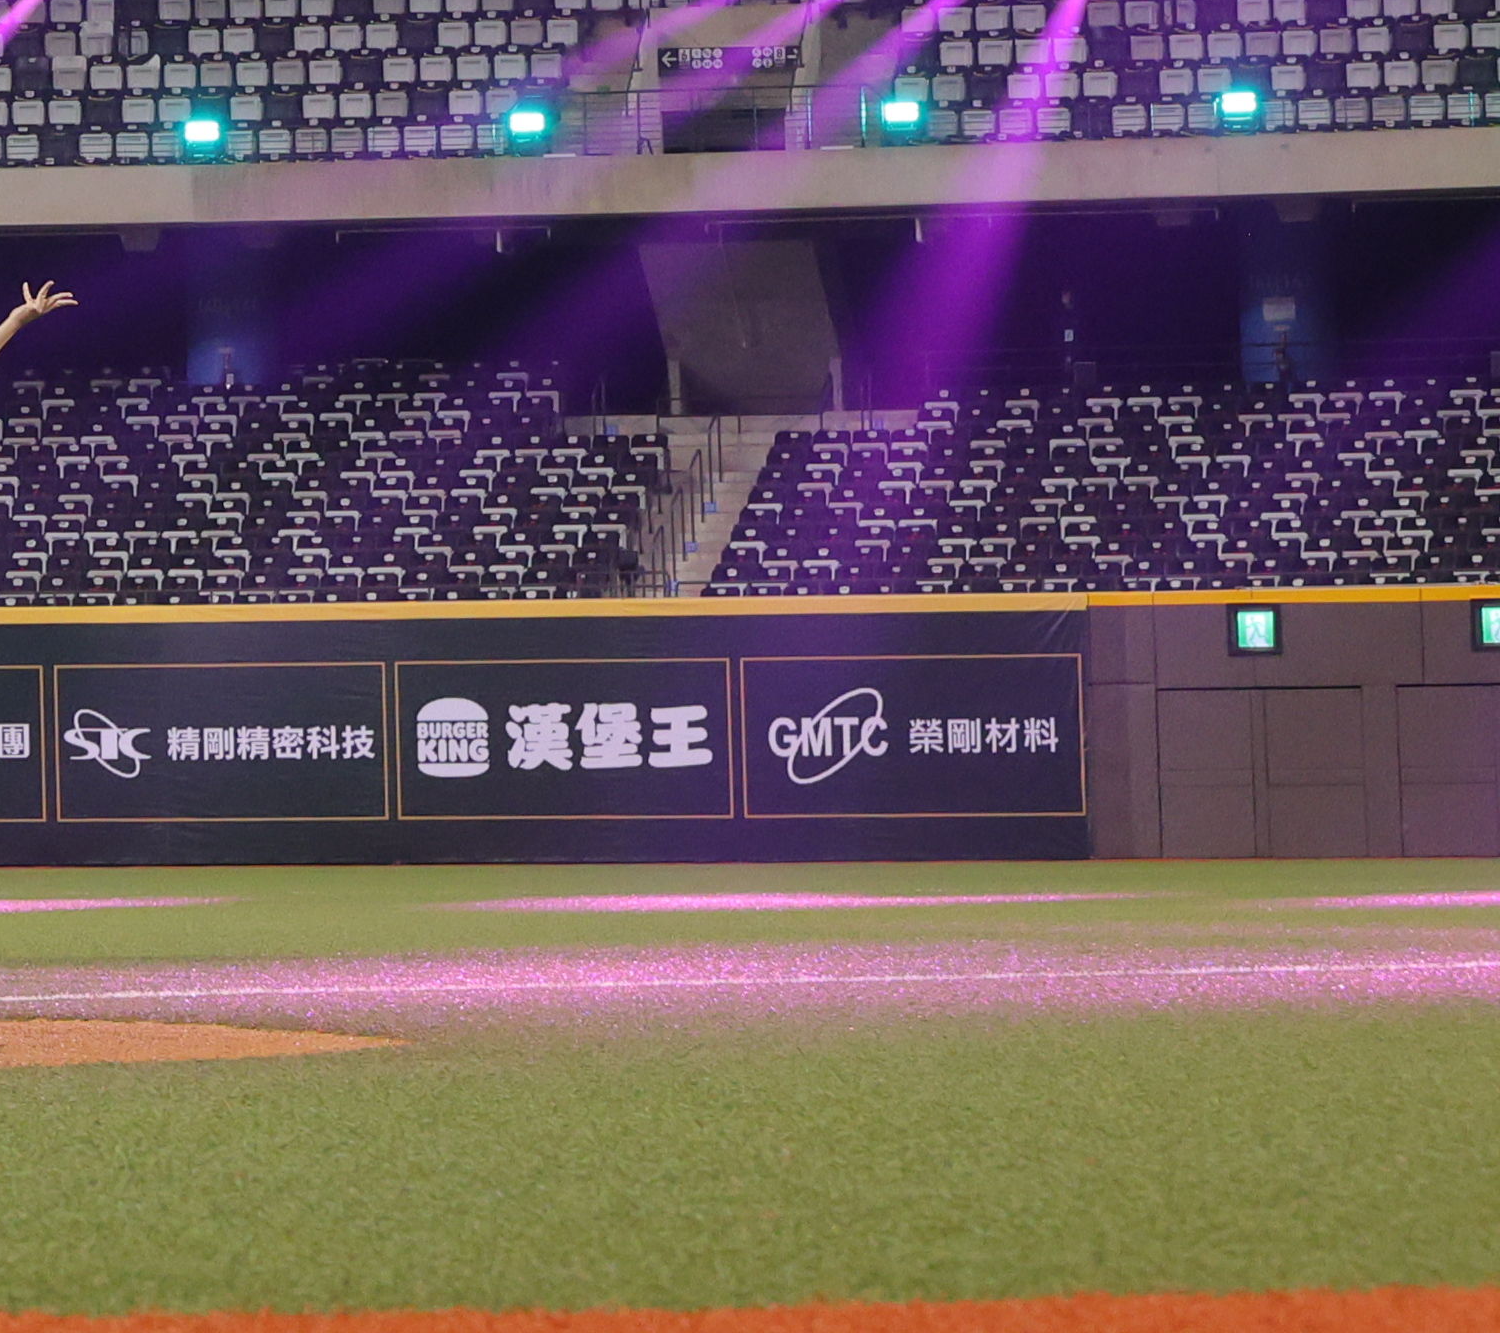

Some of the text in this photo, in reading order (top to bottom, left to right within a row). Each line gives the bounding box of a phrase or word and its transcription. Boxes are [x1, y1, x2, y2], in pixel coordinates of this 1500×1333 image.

[167, 724, 376, 761] 精剛精密科技
[416, 720, 489, 739] BURGER
[506, 702, 713, 771] 漢堡王
[908, 717, 1059, 755] 榮剛材料
[417, 739, 489, 764] KING
